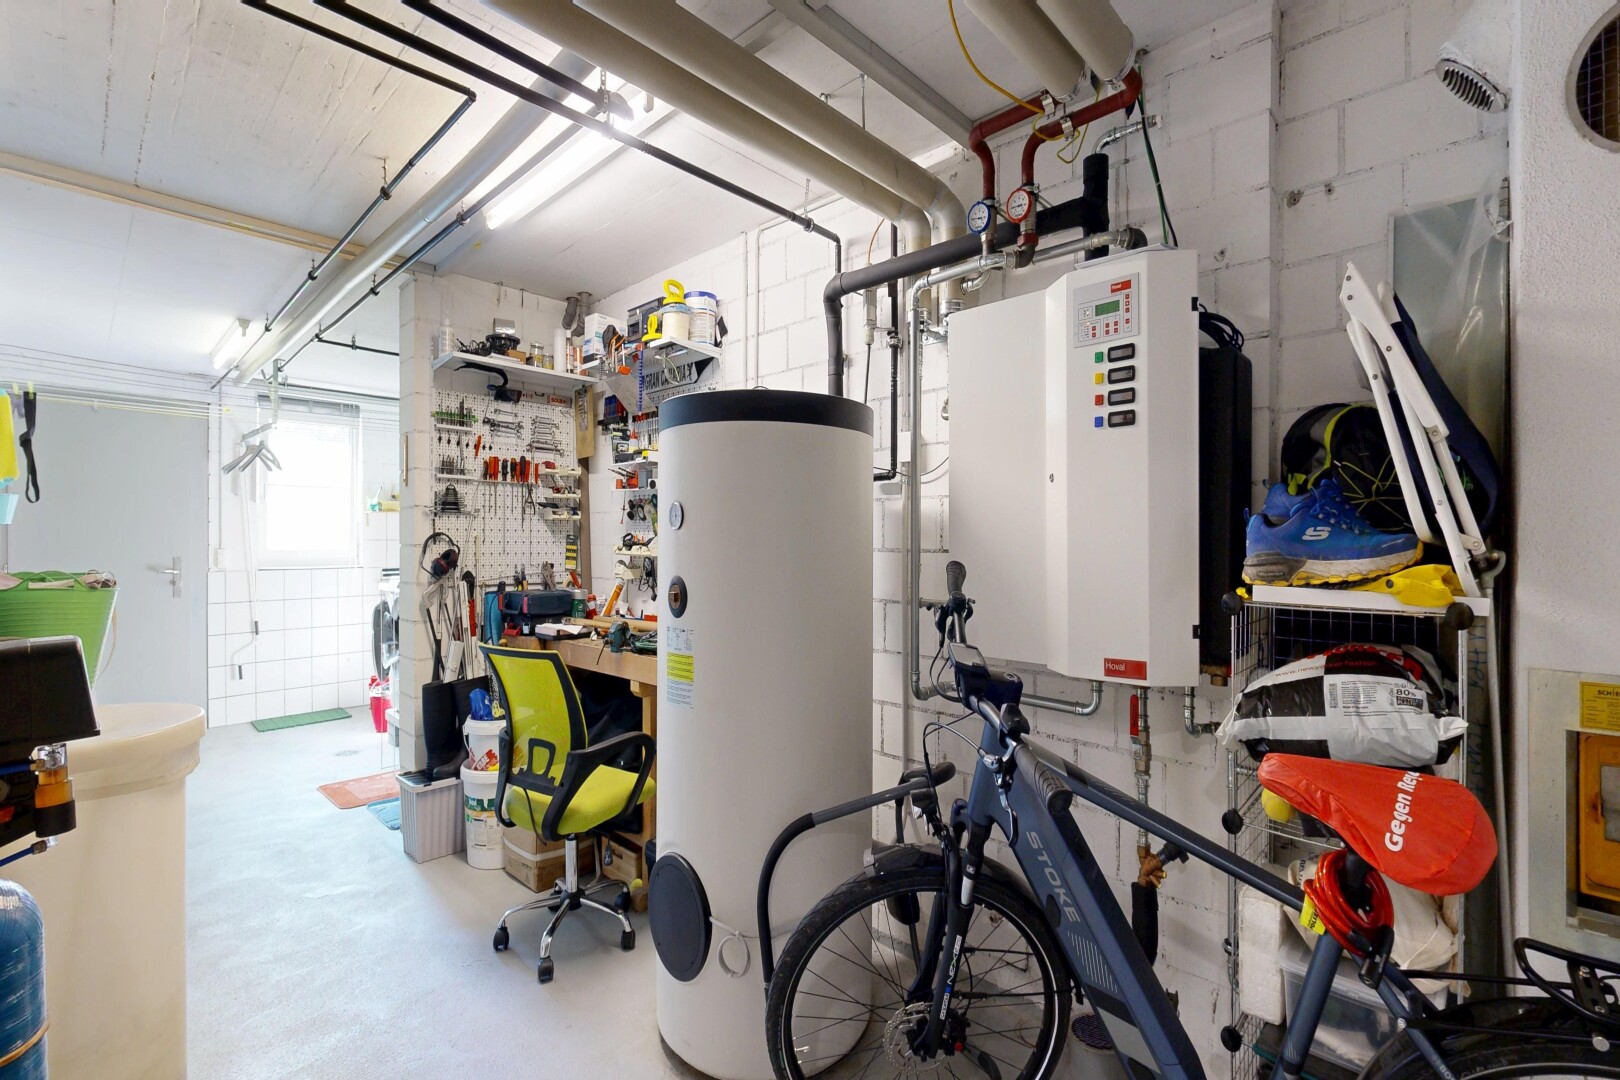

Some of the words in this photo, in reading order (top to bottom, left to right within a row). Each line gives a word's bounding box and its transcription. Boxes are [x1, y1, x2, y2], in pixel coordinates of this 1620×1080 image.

[1105, 661, 1126, 671] Hoval
[1385, 793, 1413, 852] Gegen
[1026, 831, 1081, 922] STOKE
